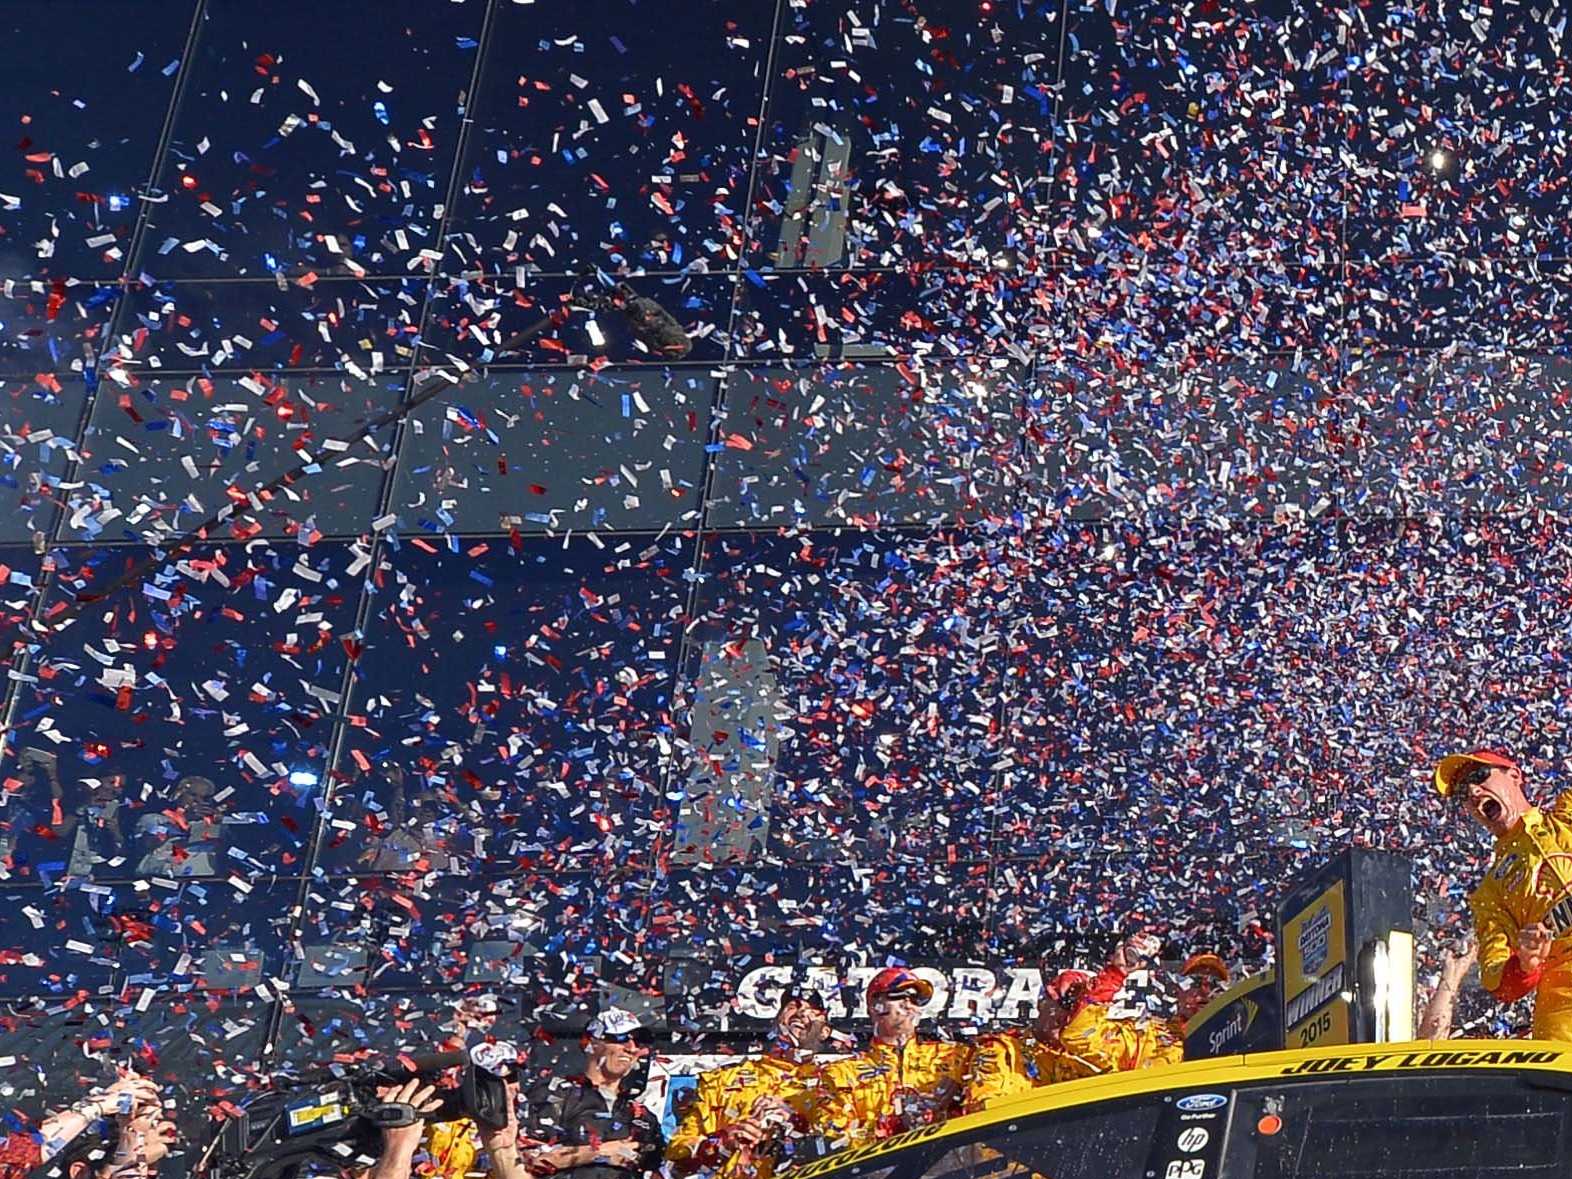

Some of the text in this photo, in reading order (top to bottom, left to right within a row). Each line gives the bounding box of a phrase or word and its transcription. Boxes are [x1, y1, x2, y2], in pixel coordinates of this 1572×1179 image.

[1287, 965, 1343, 1027] WINNER
[1209, 1015, 1243, 1053] Sprint
[1300, 1012, 1331, 1047] 2015
[1279, 1051, 1564, 1075] JOEY LOGANO
[1168, 1162, 1203, 1178] PPG
